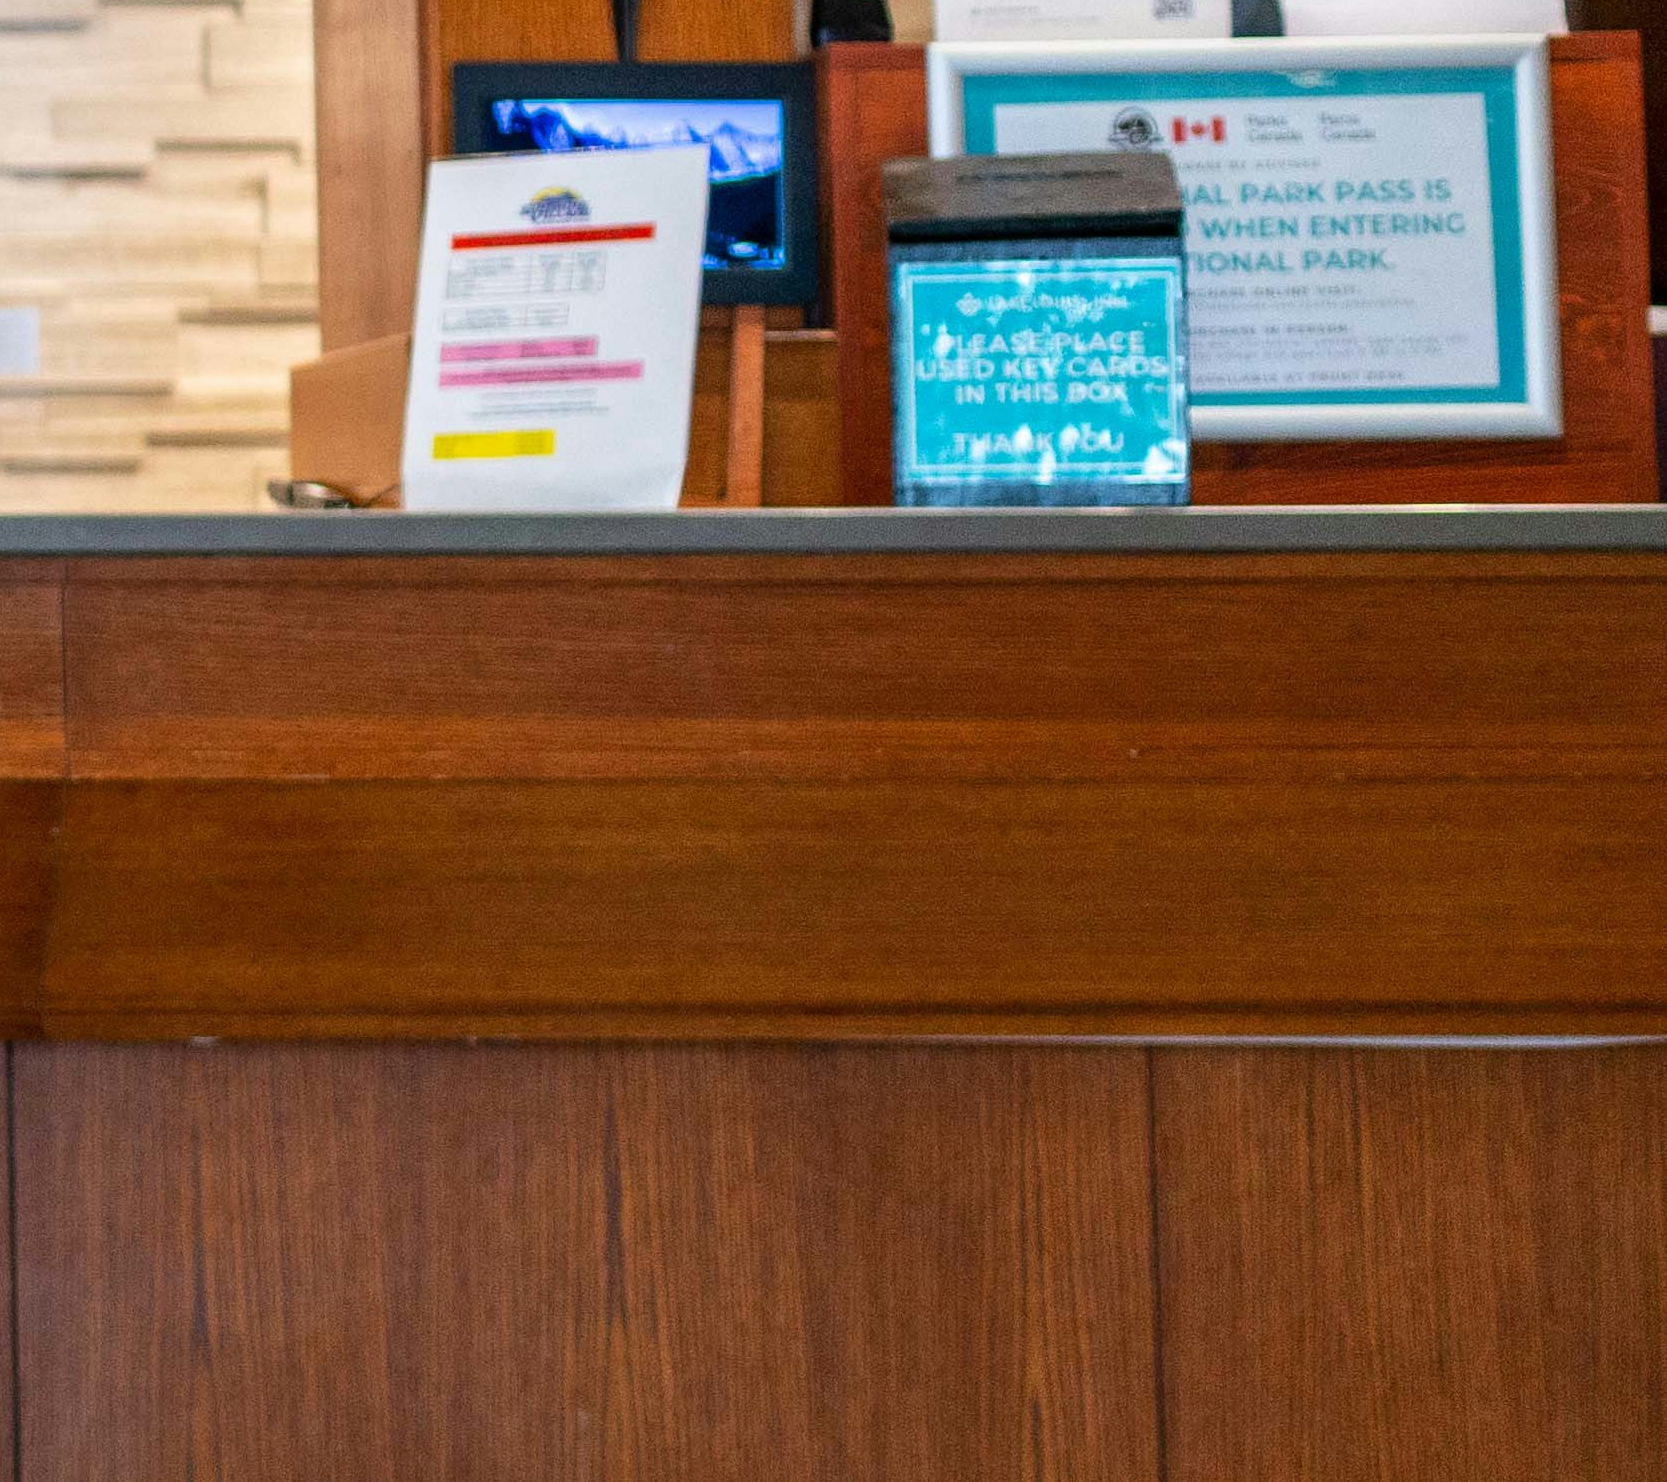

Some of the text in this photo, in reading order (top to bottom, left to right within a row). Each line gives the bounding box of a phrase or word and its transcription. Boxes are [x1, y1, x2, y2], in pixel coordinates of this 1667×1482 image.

[1240, 182, 1325, 204] PARK
[1335, 180, 1415, 203] PASS
[1424, 178, 1452, 201] IS
[1201, 213, 1467, 239] WHEN ENTERING
[939, 329, 1145, 356] PLEASE PLACE
[916, 355, 1169, 381] USED KEY CARDS
[954, 381, 1128, 405] IN THIS BOX
[952, 431, 1054, 454] THANK
